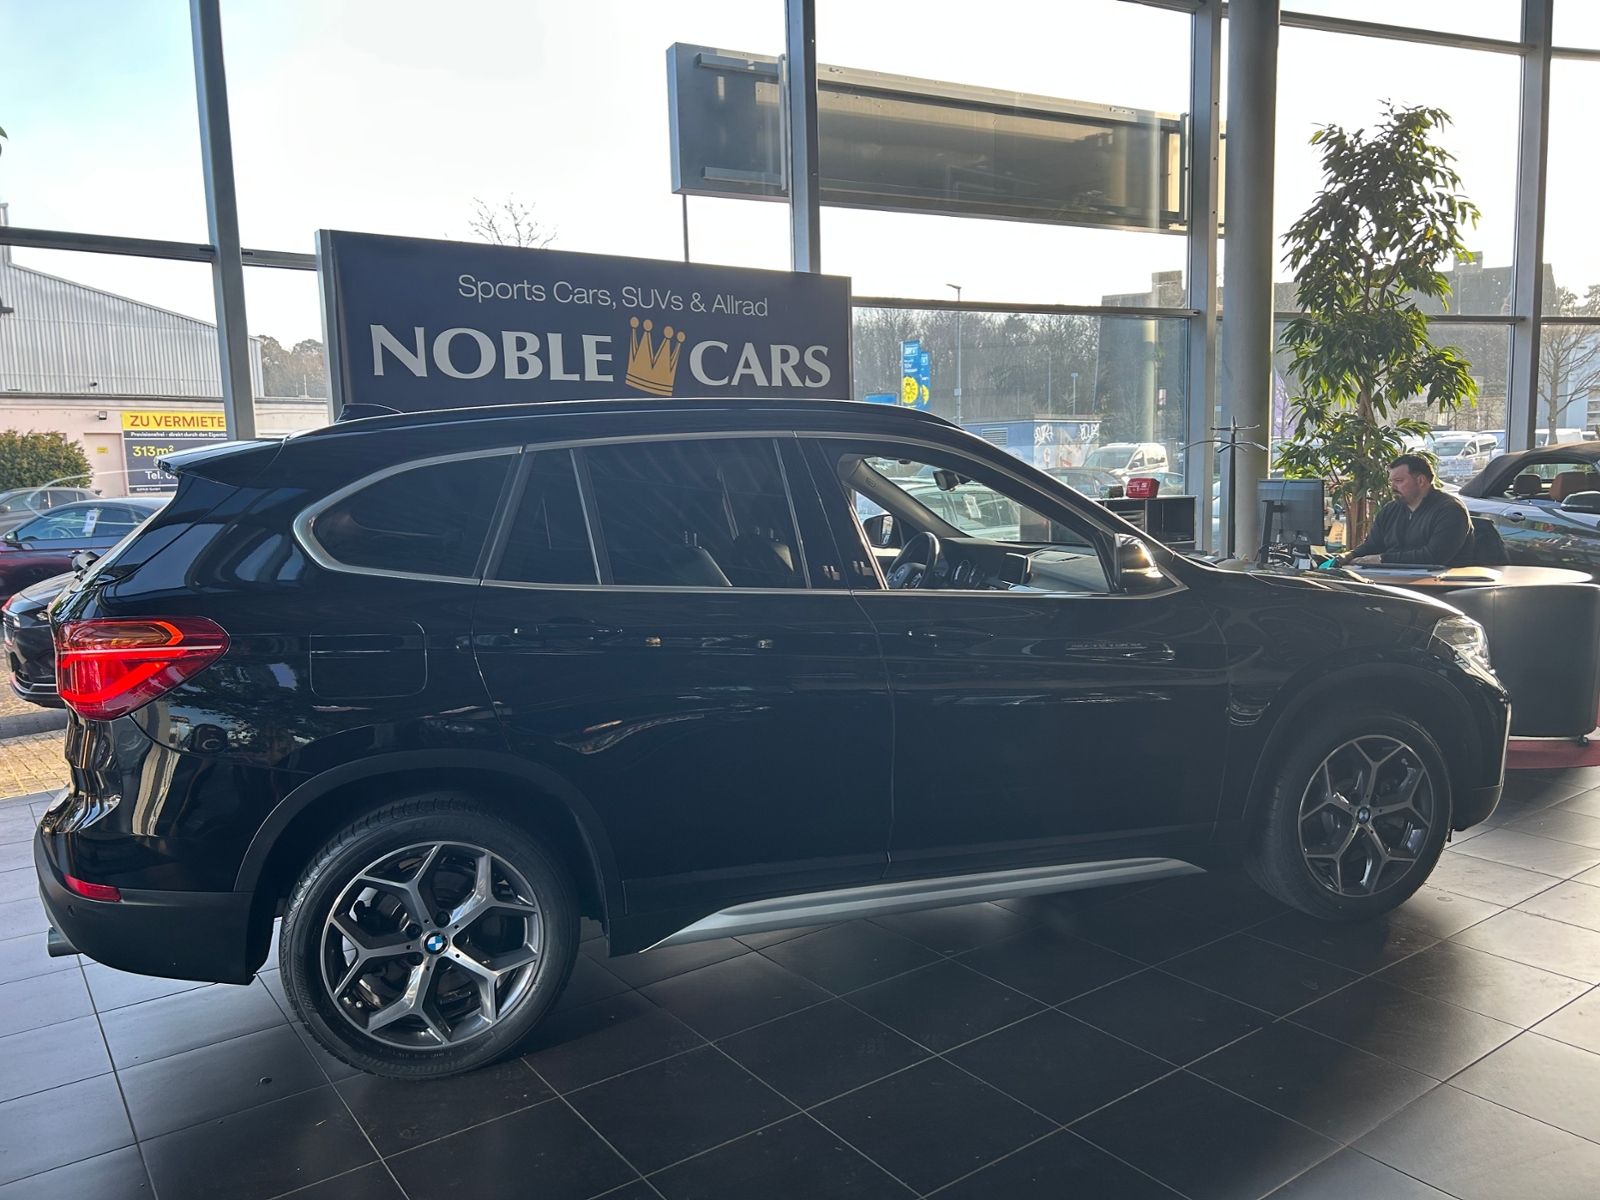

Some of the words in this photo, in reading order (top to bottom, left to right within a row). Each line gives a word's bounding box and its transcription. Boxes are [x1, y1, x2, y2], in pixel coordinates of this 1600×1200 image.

[458, 273, 546, 303] Sports
[552, 280, 617, 310] Cars,
[622, 286, 683, 311] SUVs
[690, 292, 707, 313] &
[711, 294, 768, 317] Allrad
[369, 324, 615, 383] NOBLE
[689, 340, 832, 388] CARS
[130, 415, 150, 427] ZU
[153, 415, 225, 427] VERMIETE
[145, 471, 164, 480] Tel.
